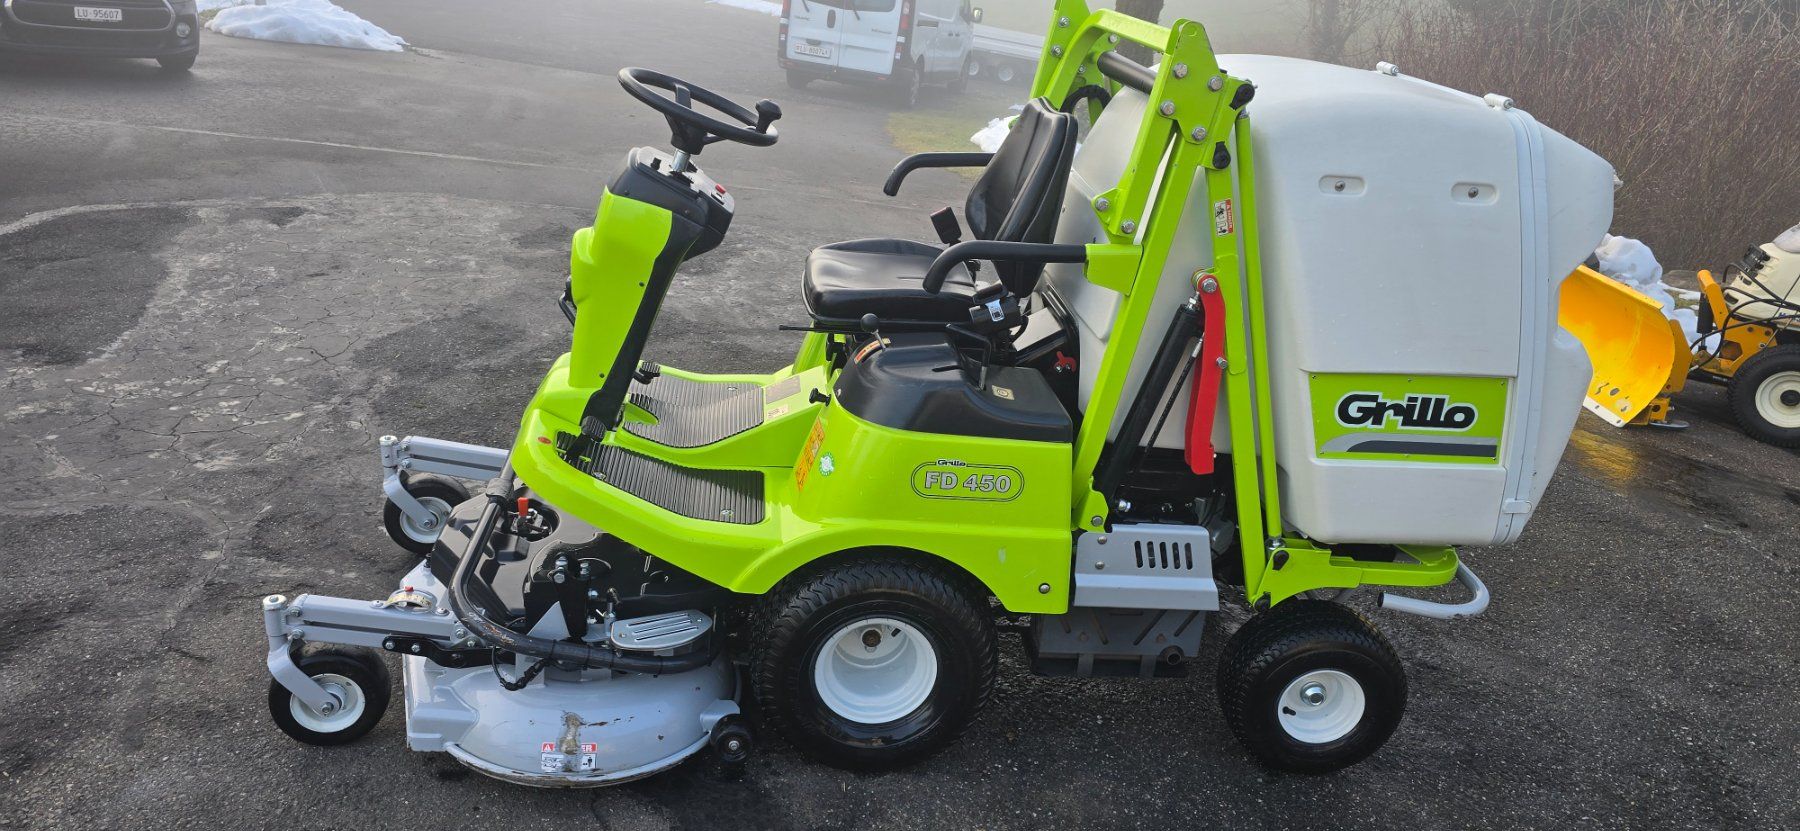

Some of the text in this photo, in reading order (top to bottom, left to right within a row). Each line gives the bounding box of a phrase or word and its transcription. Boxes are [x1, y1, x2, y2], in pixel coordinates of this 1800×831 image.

[1337, 393, 1476, 429] Grillo
[937, 459, 966, 467] Grillo
[925, 471, 1011, 493] FD 450
